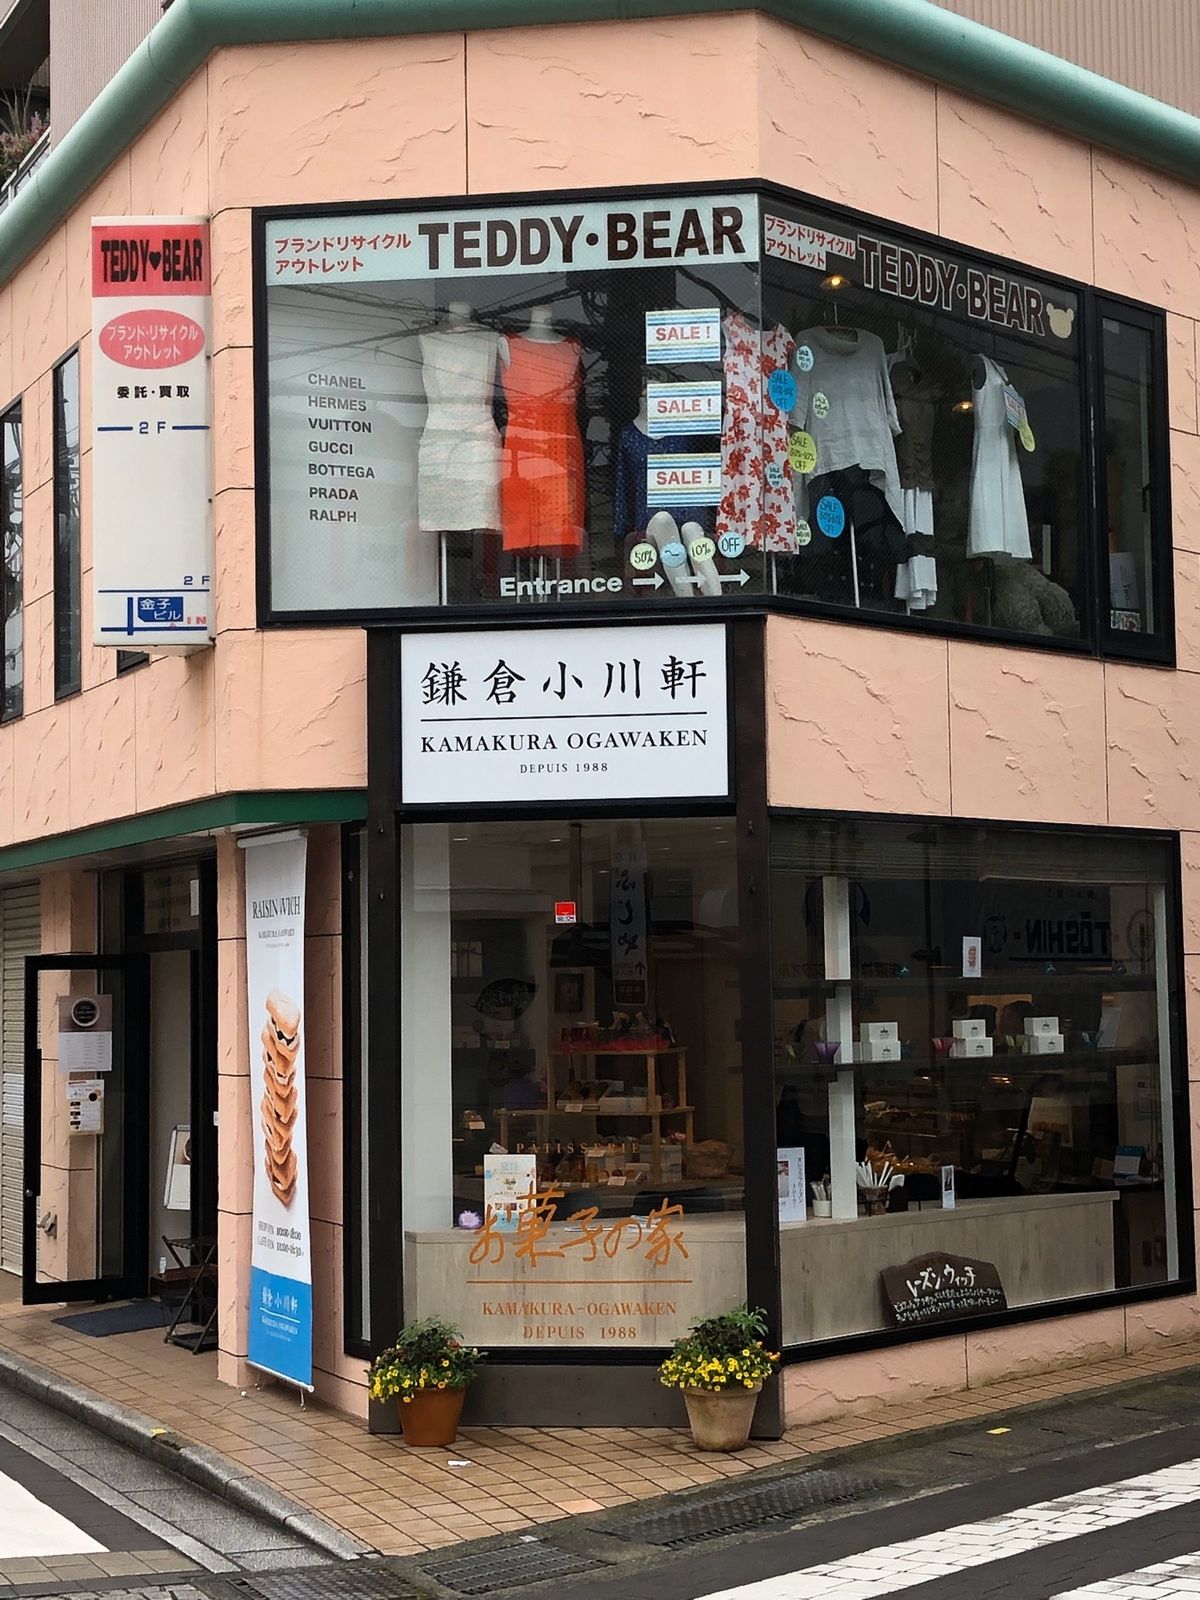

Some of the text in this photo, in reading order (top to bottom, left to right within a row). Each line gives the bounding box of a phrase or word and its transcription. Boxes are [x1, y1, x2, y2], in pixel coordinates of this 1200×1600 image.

[275, 233, 412, 254] ブランドリサイクル
[765, 216, 856, 258] ブランドリサイクル
[766, 237, 825, 267] アウトレット
[275, 256, 364, 275] アウトレット
[124, 344, 181, 360] アウトレット
[308, 373, 366, 390] CHANEL
[308, 395, 367, 412] HERMES
[308, 417, 372, 433] VUITTON
[308, 441, 353, 455] GUCCI
[790, 435, 808, 448] SALE
[308, 463, 375, 479] BOTTEGA
[795, 460, 807, 470] OFF
[309, 486, 359, 501] PRADA
[309, 509, 357, 522] RALPH
[634, 550, 653, 563] 50%
[691, 542, 711, 557] 10%
[721, 537, 740, 552] OFF
[500, 575, 623, 597] Entrance
[140, 598, 171, 610] 金子
[153, 611, 181, 620] ビル
[420, 656, 707, 706] 鎌倉小川軒
[421, 729, 708, 753] KAMAKURA OGAWAKEN
[520, 762, 608, 774] DEPUIS 1988
[468, 1180, 690, 1267] お菓子の家
[523, 1325, 637, 1339] DEPUIS 1988
